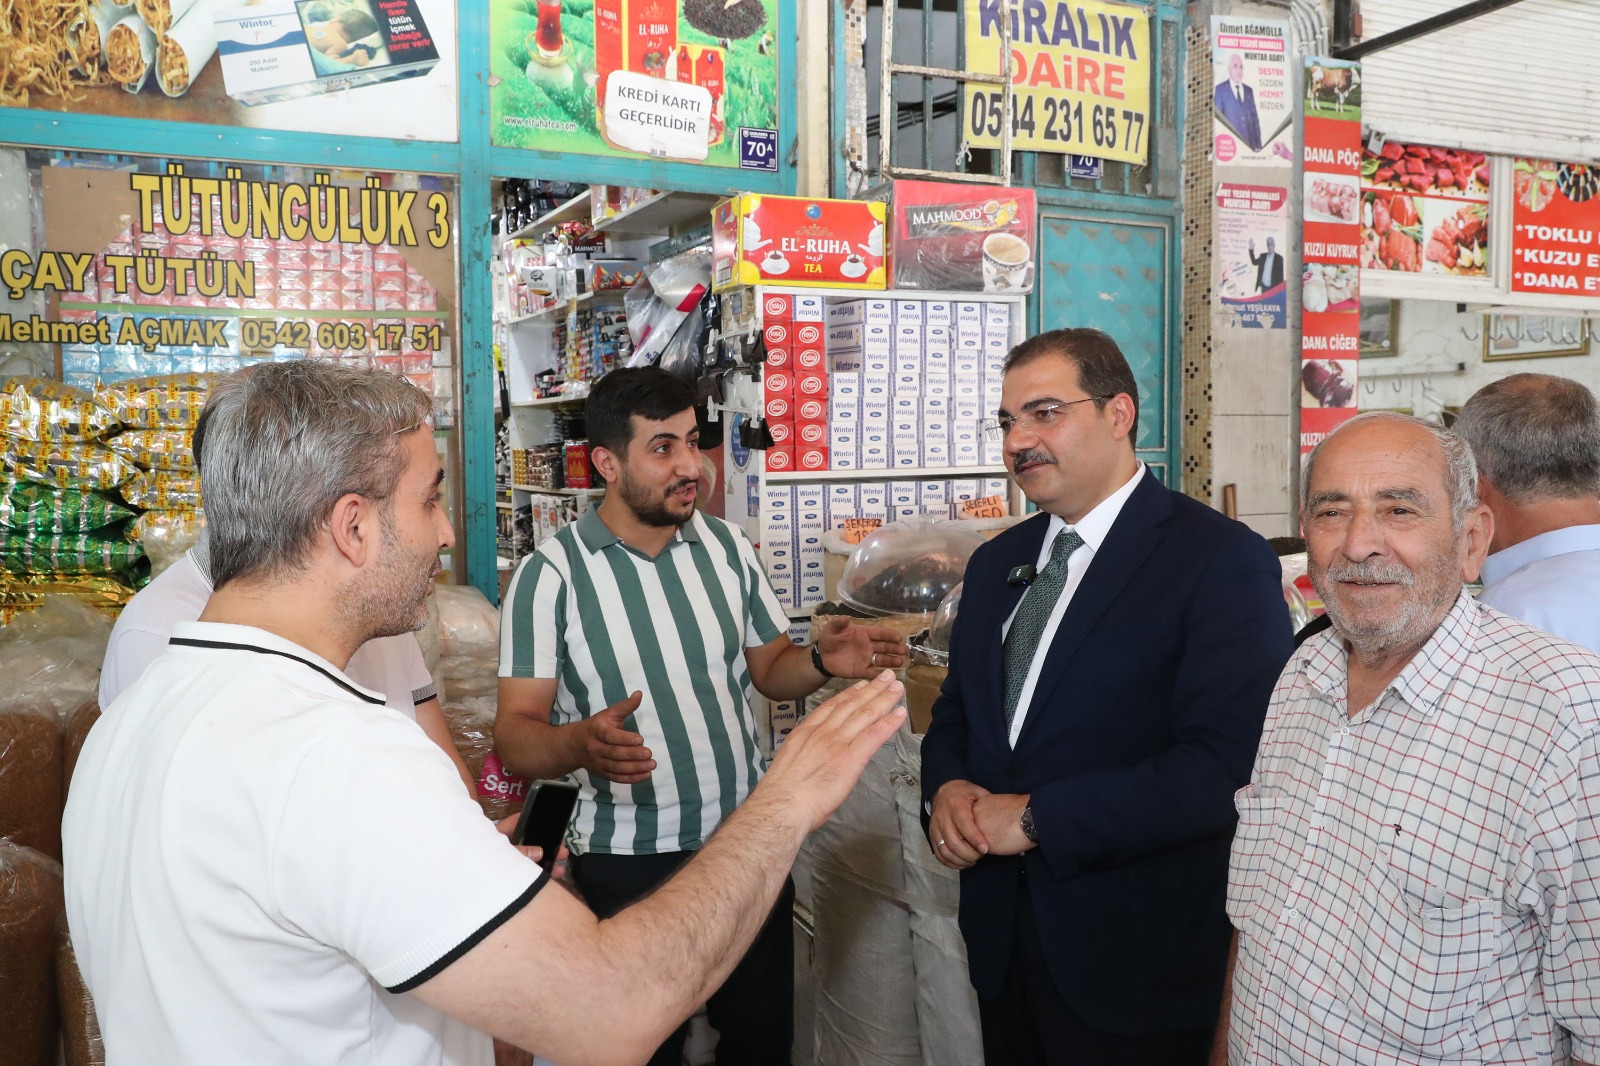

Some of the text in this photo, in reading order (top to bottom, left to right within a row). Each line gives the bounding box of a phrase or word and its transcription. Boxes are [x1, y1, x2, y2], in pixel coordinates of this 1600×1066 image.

[239, 18, 273, 29] Wintor
[388, 15, 412, 25] tütün
[639, 23, 669, 35] EL-RUHA
[1258, 67, 1285, 76] DESTEK
[1259, 78, 1284, 88] SİZDEN
[618, 85, 701, 113] KREDİ KARTI
[1259, 100, 1285, 110] BİZDEN
[619, 107, 697, 134] GEÇERLİDİR
[1043, 97, 1084, 143] 231
[1092, 104, 1117, 149] 65
[1122, 110, 1145, 154] 77
[1304, 146, 1361, 170] DANA PÖÇ
[130, 163, 450, 249] TÜTÜNCÜLÜK 3
[912, 208, 982, 225] MAHMOOD
[781, 237, 852, 254] EL-RUHA
[1304, 242, 1358, 259] KUZU KUYRUK
[0, 249, 256, 301] ÇAY TÜTÜN
[803, 263, 823, 273] TEA
[836, 306, 855, 316] Wintor
[0, 313, 442, 356] Mehmet AÇMAK 0542 603 17 51
[836, 330, 853, 339] Wintor
[1302, 333, 1358, 351] DANA CİĞER
[836, 362, 853, 371] Wintor
[773, 712, 795, 720] Wintor
[483, 773, 523, 796] Sert
